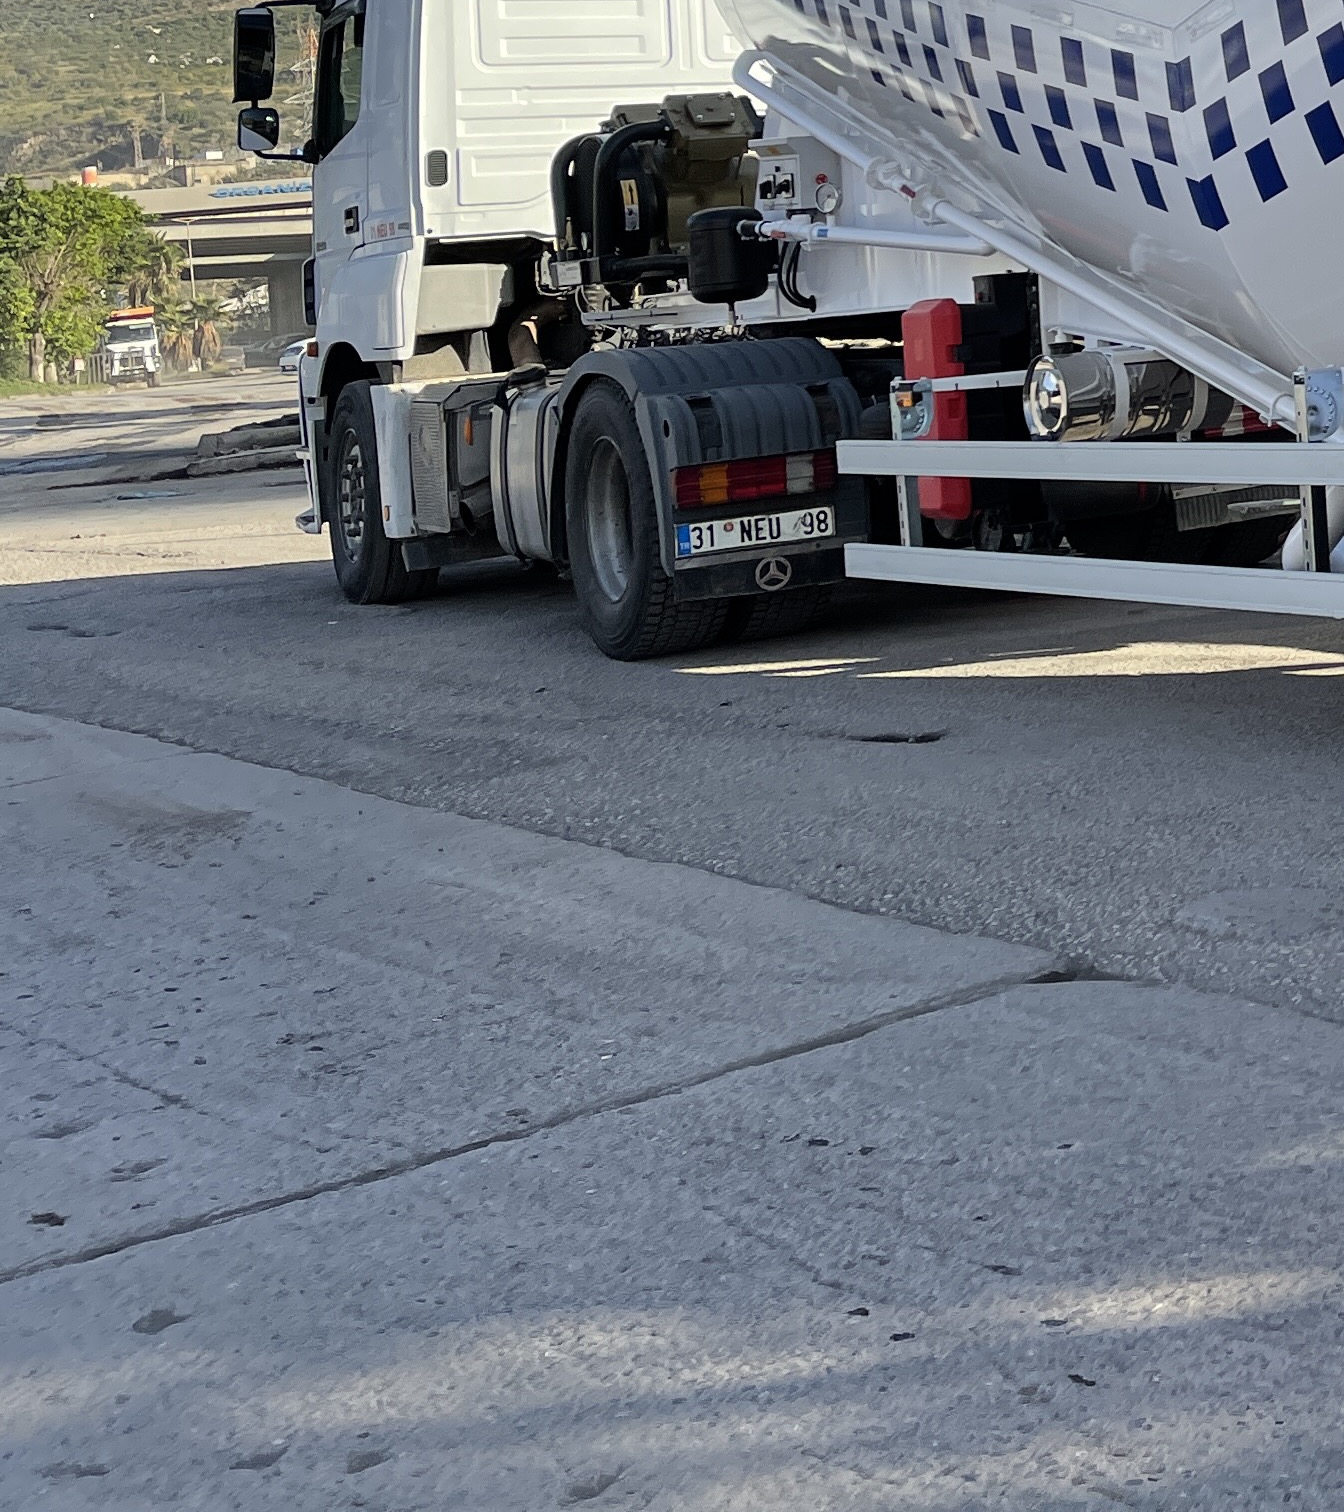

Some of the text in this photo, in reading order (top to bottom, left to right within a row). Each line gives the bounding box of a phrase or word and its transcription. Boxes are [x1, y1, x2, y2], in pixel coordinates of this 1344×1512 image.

[690, 509, 829, 550] 31 NEU 98
